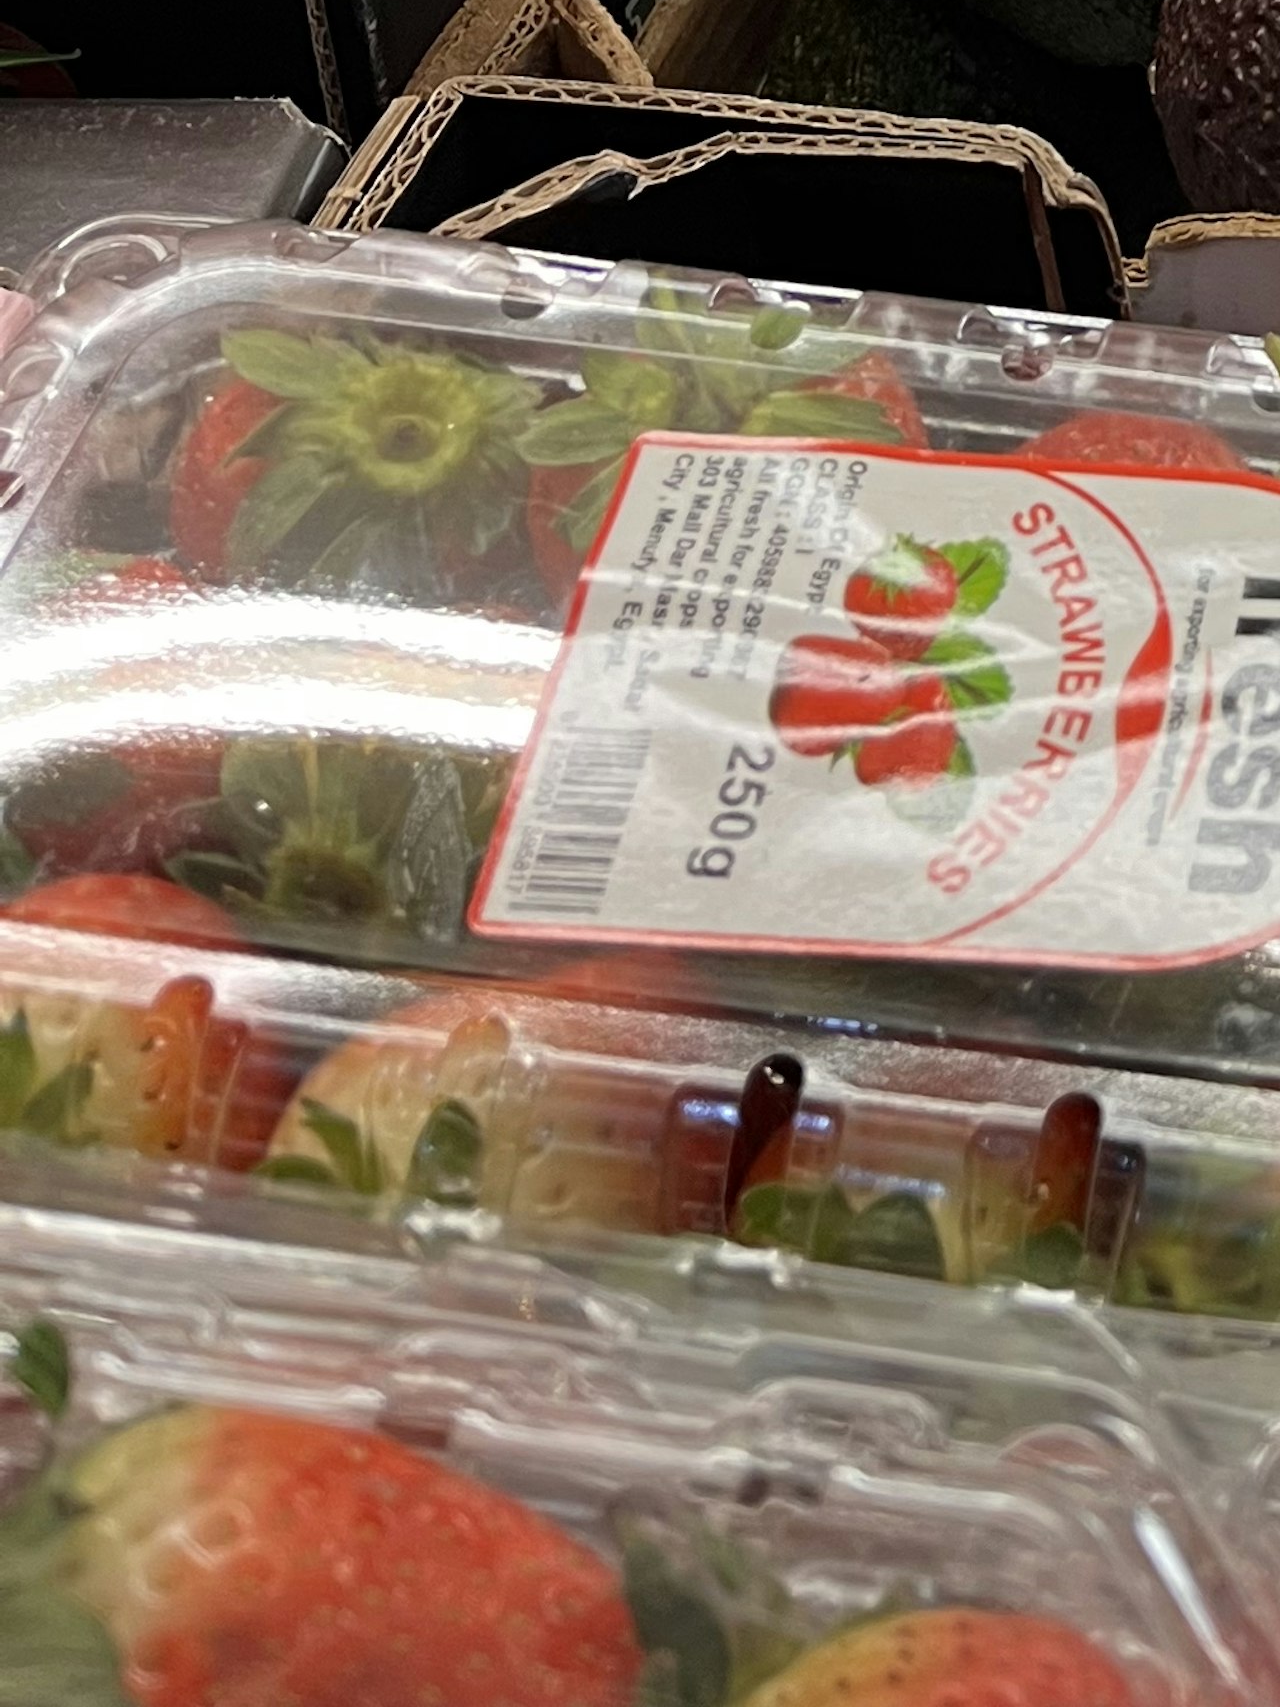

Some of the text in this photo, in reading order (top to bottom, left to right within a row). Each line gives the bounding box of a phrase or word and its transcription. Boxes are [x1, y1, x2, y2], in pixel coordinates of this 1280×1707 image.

[660, 452, 695, 490] City
[695, 454, 722, 487] 303
[681, 494, 710, 532] Mall
[696, 456, 751, 562] agricultural
[737, 489, 773, 538] fresh
[668, 537, 696, 566] Dar
[728, 544, 755, 568] for
[927, 500, 1111, 898] STRAWBERRIES
[686, 743, 777, 884] 250g
